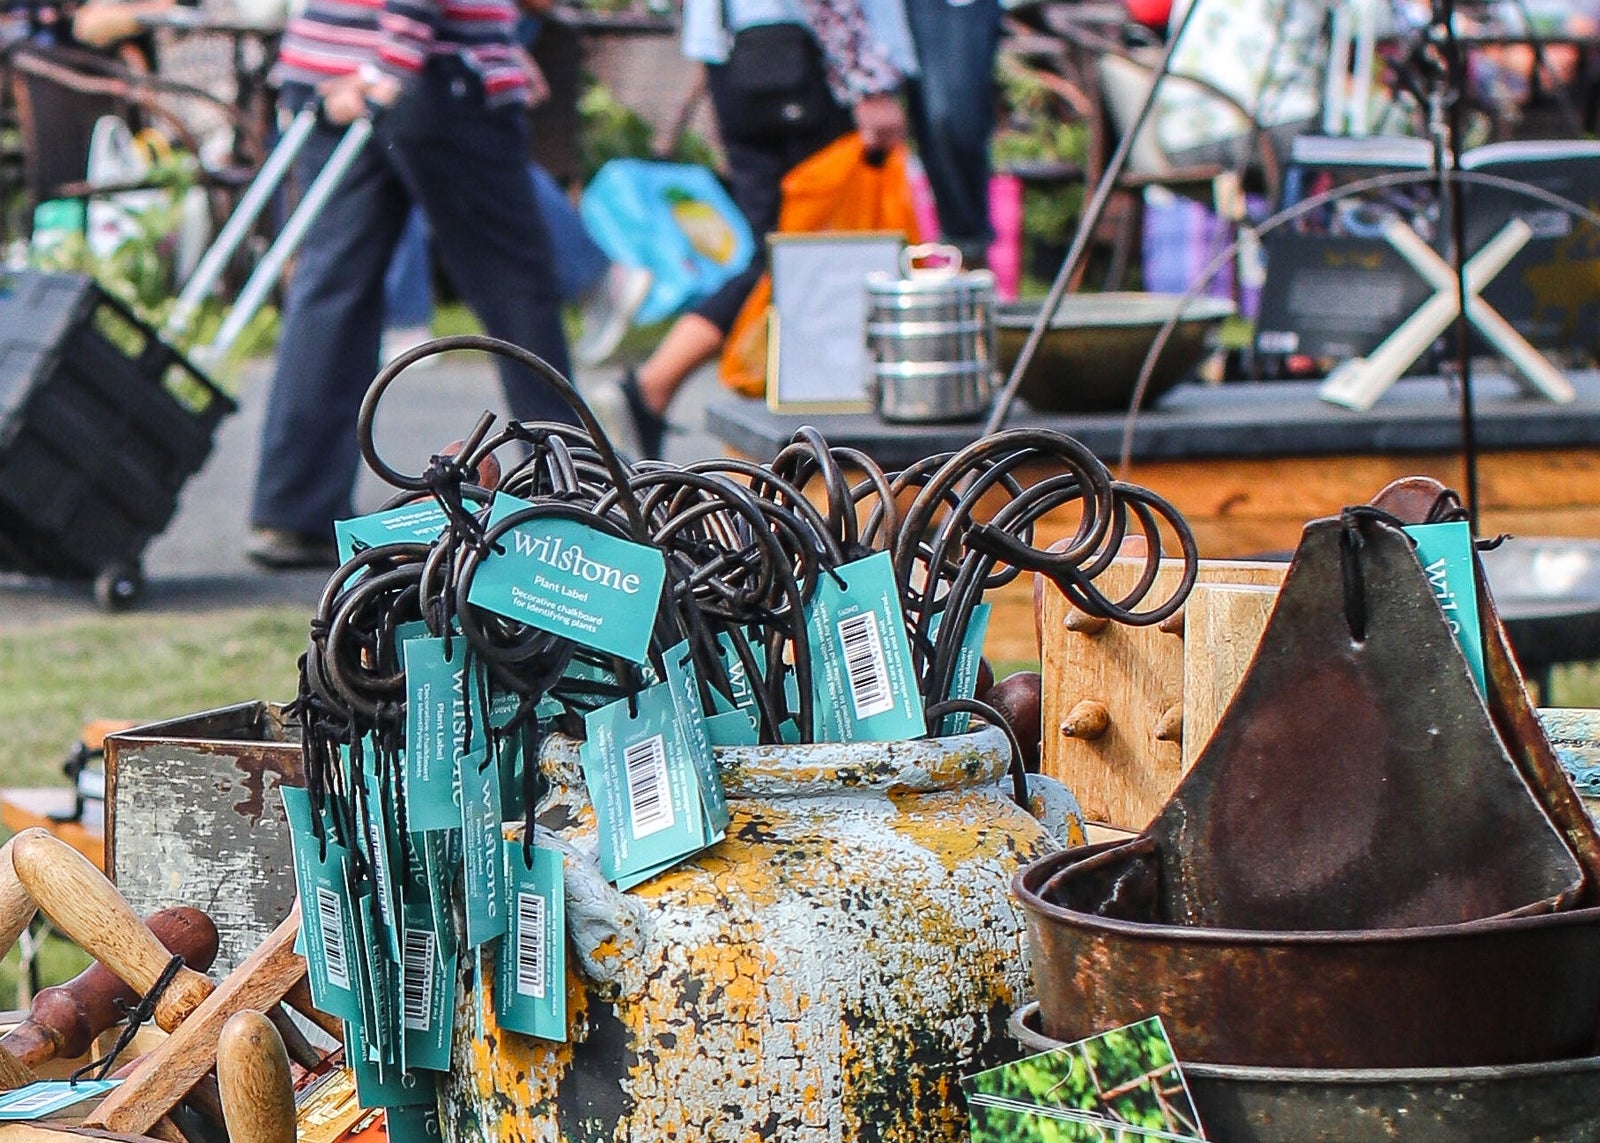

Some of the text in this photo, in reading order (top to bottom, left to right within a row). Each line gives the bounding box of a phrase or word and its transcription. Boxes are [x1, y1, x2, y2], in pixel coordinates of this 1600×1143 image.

[514, 529, 640, 594] wilstone
[512, 586, 603, 626] Decorative chalkboard
[534, 575, 589, 602] Plant Label
[513, 596, 526, 608] for
[571, 618, 597, 633] plants
[824, 662, 834, 681] Steel
[886, 650, 894, 663] and
[889, 664, 897, 680] care
[423, 684, 431, 730] Decorative
[436, 703, 444, 760] Plant Label
[482, 779, 498, 919] wilstone
